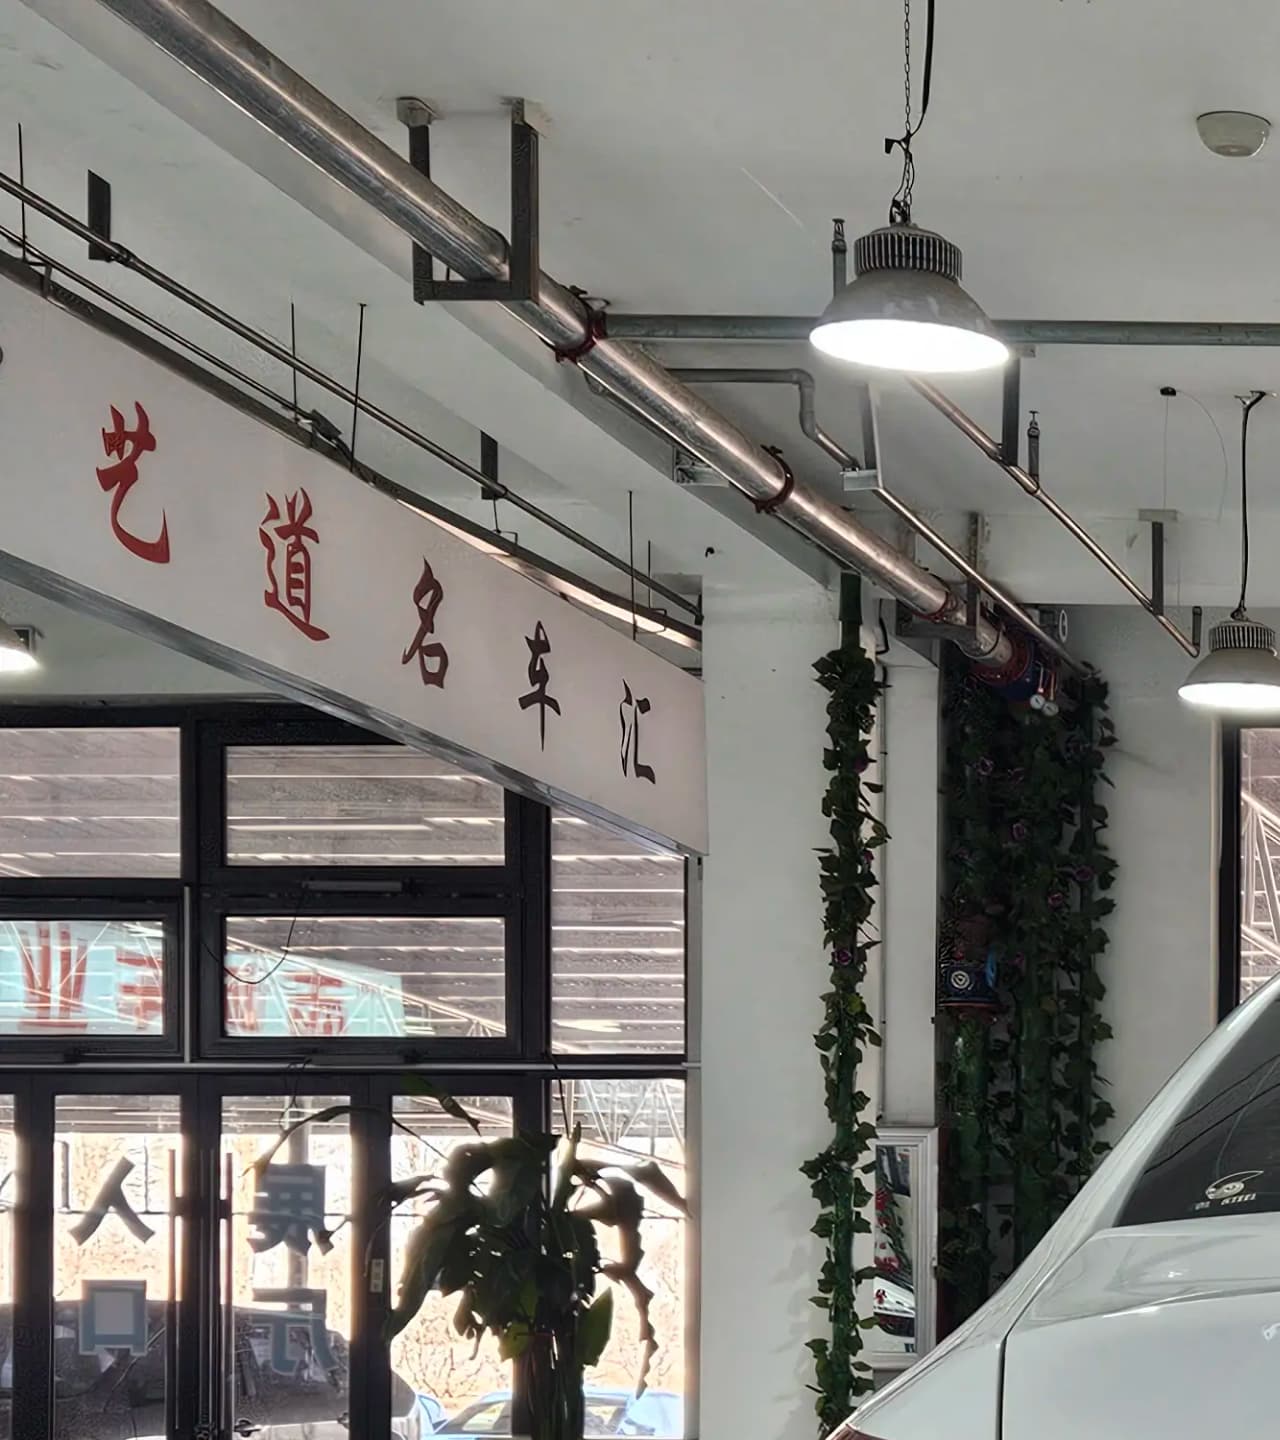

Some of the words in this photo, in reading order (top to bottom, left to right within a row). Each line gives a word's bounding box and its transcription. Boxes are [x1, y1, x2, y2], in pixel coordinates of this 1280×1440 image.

[95, 400, 656, 785] 艺道名车汇
